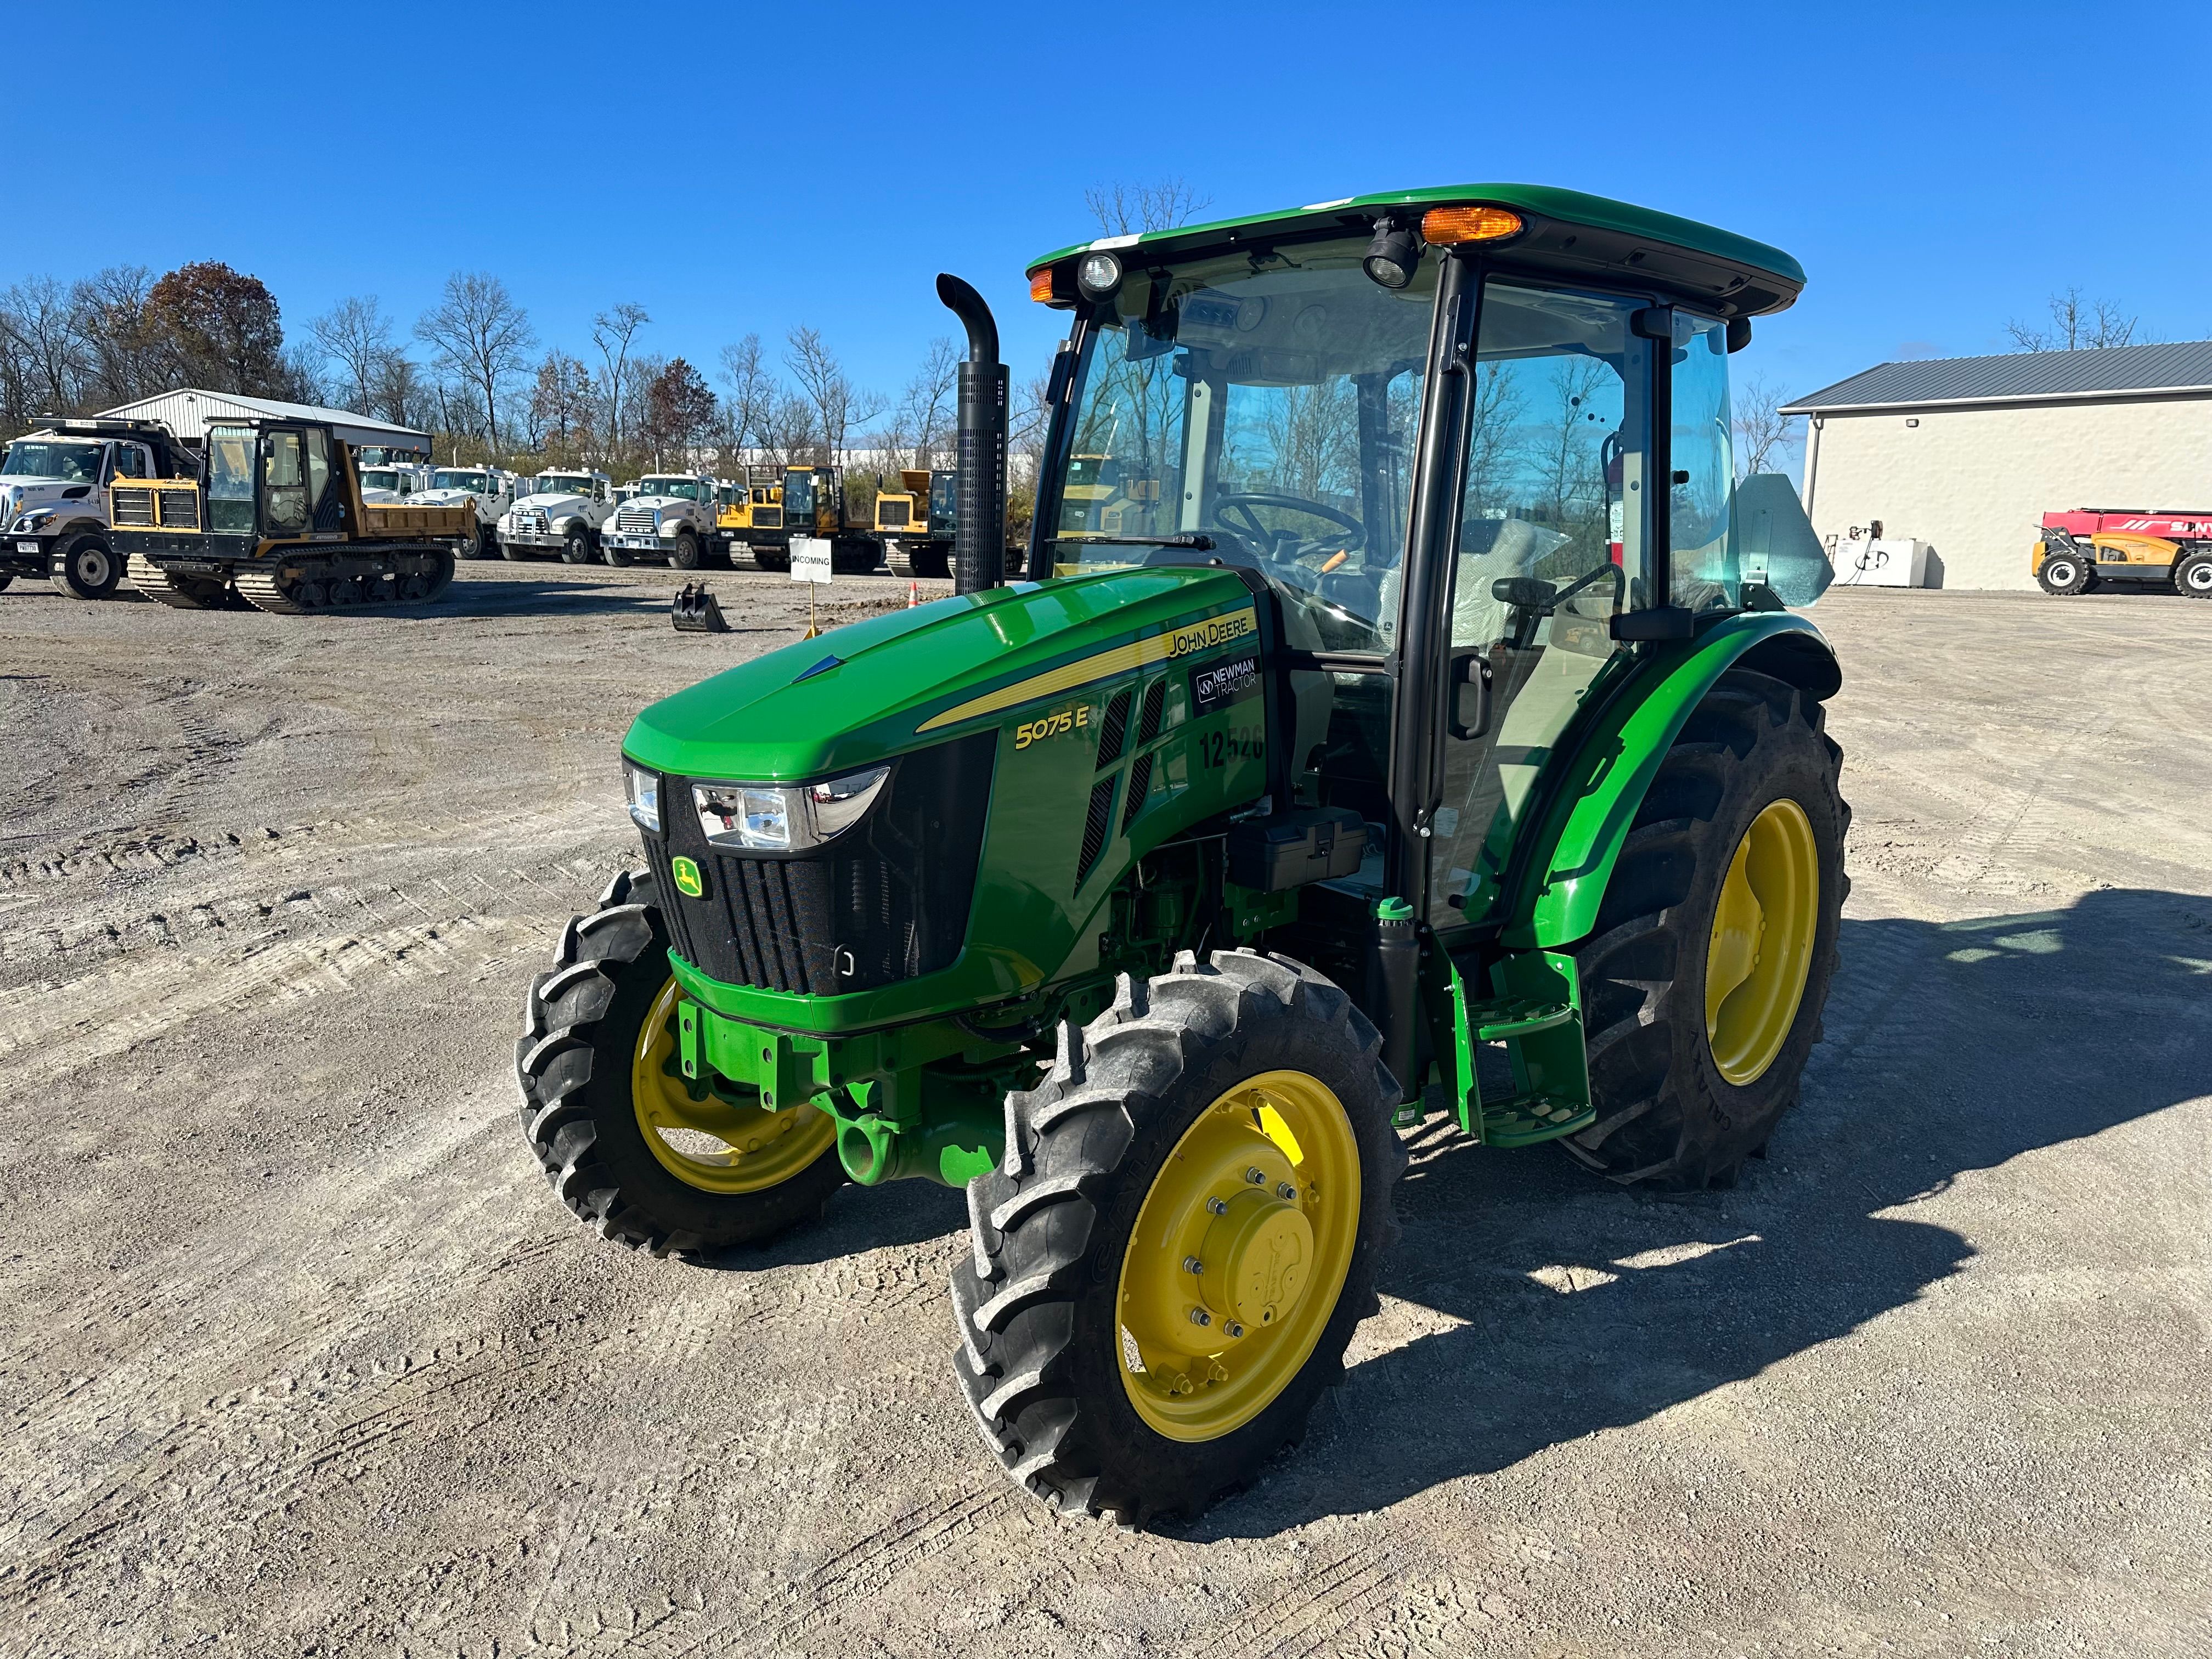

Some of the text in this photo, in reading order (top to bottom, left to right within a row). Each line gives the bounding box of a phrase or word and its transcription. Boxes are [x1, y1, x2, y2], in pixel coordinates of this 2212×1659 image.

[792, 555, 830, 566] INCOMING
[1169, 617, 1249, 657] JOHN DEERE
[1212, 658, 1255, 685] NEWMAN
[1214, 672, 1256, 697] TRACTOR
[1199, 724, 1263, 769] 12526
[1689, 1029, 1731, 1132] GALAXY
[1092, 1039, 1248, 1284] GALAXY
